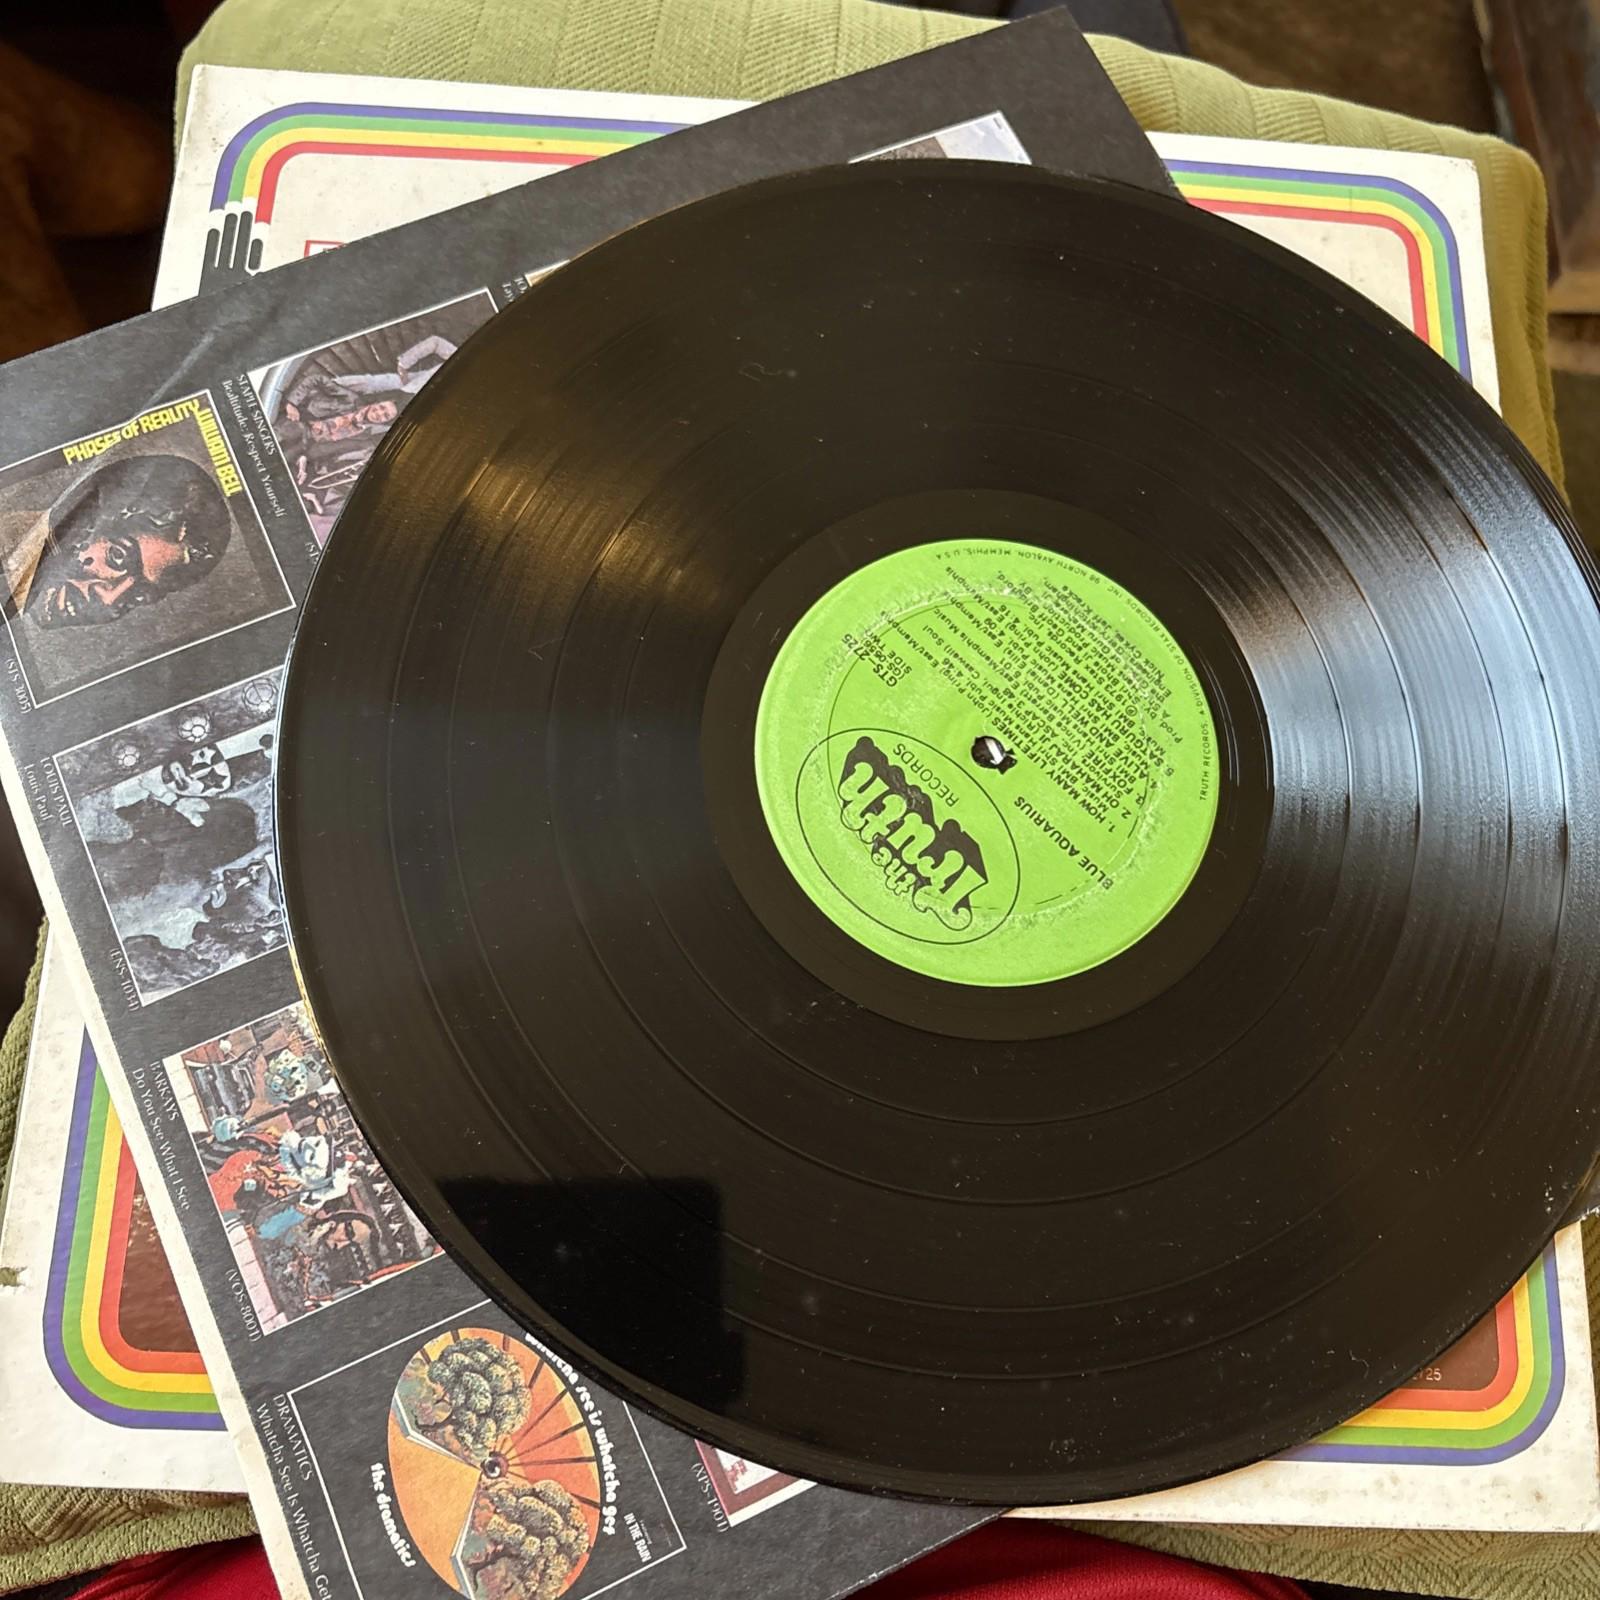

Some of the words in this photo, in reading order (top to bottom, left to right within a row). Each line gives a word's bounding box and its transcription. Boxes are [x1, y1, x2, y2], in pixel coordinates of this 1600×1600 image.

[236, 374, 257, 407] STAPLE
[253, 410, 275, 455] SINGERS
[63, 431, 121, 465] PHASES
[122, 422, 140, 439] OF
[139, 398, 200, 433] REALITY
[198, 408, 231, 467] WILLIAM
[216, 463, 243, 497] BELL
[243, 433, 266, 473] Respect
[261, 475, 286, 517] Yourself
[1056, 559, 1086, 575] NORTH
[1019, 582, 1033, 595] By
[999, 604, 1020, 624] 4:16
[1029, 612, 1044, 630] Inc.
[1038, 613, 1065, 637] Geoff
[1092, 615, 1112, 630] Jeff
[922, 625, 944, 646] Soul
[984, 618, 1005, 637] 4:09
[1005, 621, 1032, 648] Pring)
[1023, 624, 1045, 647] Publ.
[1008, 637, 1030, 660] Publ.
[1047, 628, 1083, 665] Records,
[1065, 636, 1083, 652] and
[1087, 632, 1111, 654] Guru
[887, 650, 912, 674] SIDE
[942, 658, 964, 677] 4:46
[943, 644, 980, 679] Caswell)
[960, 632, 1020, 690] East/Memphis
[1003, 647, 1027, 669] Ellis)
[1033, 644, 1059, 672] (John
[1045, 646, 1071, 671] Music
[1091, 647, 1116, 672] Music
[1109, 654, 1121, 664] of
[1143, 658, 1165, 680] Nick
[1174, 654, 1183, 665] OF
[939, 667, 968, 694] Pring)
[1026, 668, 1060, 699] (Daniel
[1030, 659, 1056, 684] Music
[1072, 670, 1095, 692] Hans
[1084, 664, 1105, 685] Stax
[966, 678, 988, 702] Publ.
[1023, 680, 1045, 701] Publ.
[1057, 671, 1089, 699] COME
[1057, 683, 1080, 705] Hans
[1104, 684, 1127, 706] 1973
[1119, 685, 1141, 705] Shri
[1150, 688, 1165, 703] the
[1181, 667, 1201, 705] DIVISION
[967, 692, 993, 718] (John
[1002, 688, 1025, 709] 3:48
[1019, 689, 1056, 722] Barrett)
[1088, 698, 1112, 721] HAS
[1094, 691, 1116, 711] Shri
[988, 700, 1015, 725] Music
[1007, 703, 1040, 734] (Richie
[1024, 710, 1059, 738] ASCAP
[1046, 699, 1072, 725] Music
[1061, 698, 1090, 728] WELL
[1079, 705, 1100, 724] Shri
[1115, 710, 1136, 728] BMI
[1162, 710, 1171, 719] A
[991, 717, 1047, 769] LIFETIMES
[1015, 724, 1038, 747] Hans
[1039, 734, 1051, 743] JI
[1056, 721, 1086, 750] (Vince
[1072, 724, 1095, 746] Hans
[1089, 726, 1115, 748] AND
[1100, 724, 1120, 742] BMI
[1111, 719, 1164, 767] SATGURU
[1139, 727, 1166, 756] Music,
[1159, 719, 1183, 743] Prod.
[1036, 746, 1058, 766] Shri
[1062, 738, 1078, 757] Inc.
[1095, 745, 1116, 765] Shri
[1124, 741, 1151, 770] Music,
[893, 743, 959, 807] RECORDS
[1048, 744, 1103, 793] MAHARAJ
[1058, 765, 1078, 784] BMI
[1085, 749, 1134, 795] FOXFIRE
[1113, 748, 1149, 779] ALIVE
[1116, 765, 1137, 784] BMI
[1046, 769, 1081, 800] MANY
[1081, 755, 1124, 799] Survivors,
[1146, 778, 1157, 789] 4.
[1199, 772, 1208, 800] TRUTH
[23, 764, 41, 794] Louis
[35, 795, 55, 820] Paul
[40, 757, 60, 794] LOUIS
[53, 795, 72, 827] PAUL
[1082, 783, 1109, 813] Music,
[1101, 791, 1120, 808] OH
[1135, 793, 1145, 805] 3.
[1078, 799, 1106, 824] HOW
[1121, 807, 1132, 819] 2.
[1014, 796, 1080, 857] AQUARIUS
[1105, 820, 1117, 833] 1.
[871, 846, 916, 896] the
[1078, 856, 1114, 890] BLUE
[150, 1061, 179, 1121] BARKAYS
[132, 1068, 145, 1088] Do
[141, 1089, 155, 1116] You
[150, 1117, 164, 1140] See
[159, 1141, 179, 1177] What
[175, 1186, 190, 1210] See
[273, 1394, 312, 1480] DRAMATICS
[575, 1386, 595, 1412] see
[588, 1410, 602, 1426] is
[595, 1427, 621, 1503] whatcha
[371, 1463, 386, 1491] the
[256, 1403, 284, 1464] Whatcha
[278, 1465, 293, 1492] See
[287, 1493, 299, 1507] Is
[293, 1507, 320, 1573] Whatcha
[315, 1575, 332, 1600] Get
[377, 1493, 416, 1567] dramatics
[624, 1513, 636, 1525] IN
[629, 1522, 643, 1540] THE
[635, 1539, 651, 1562] RAIN
